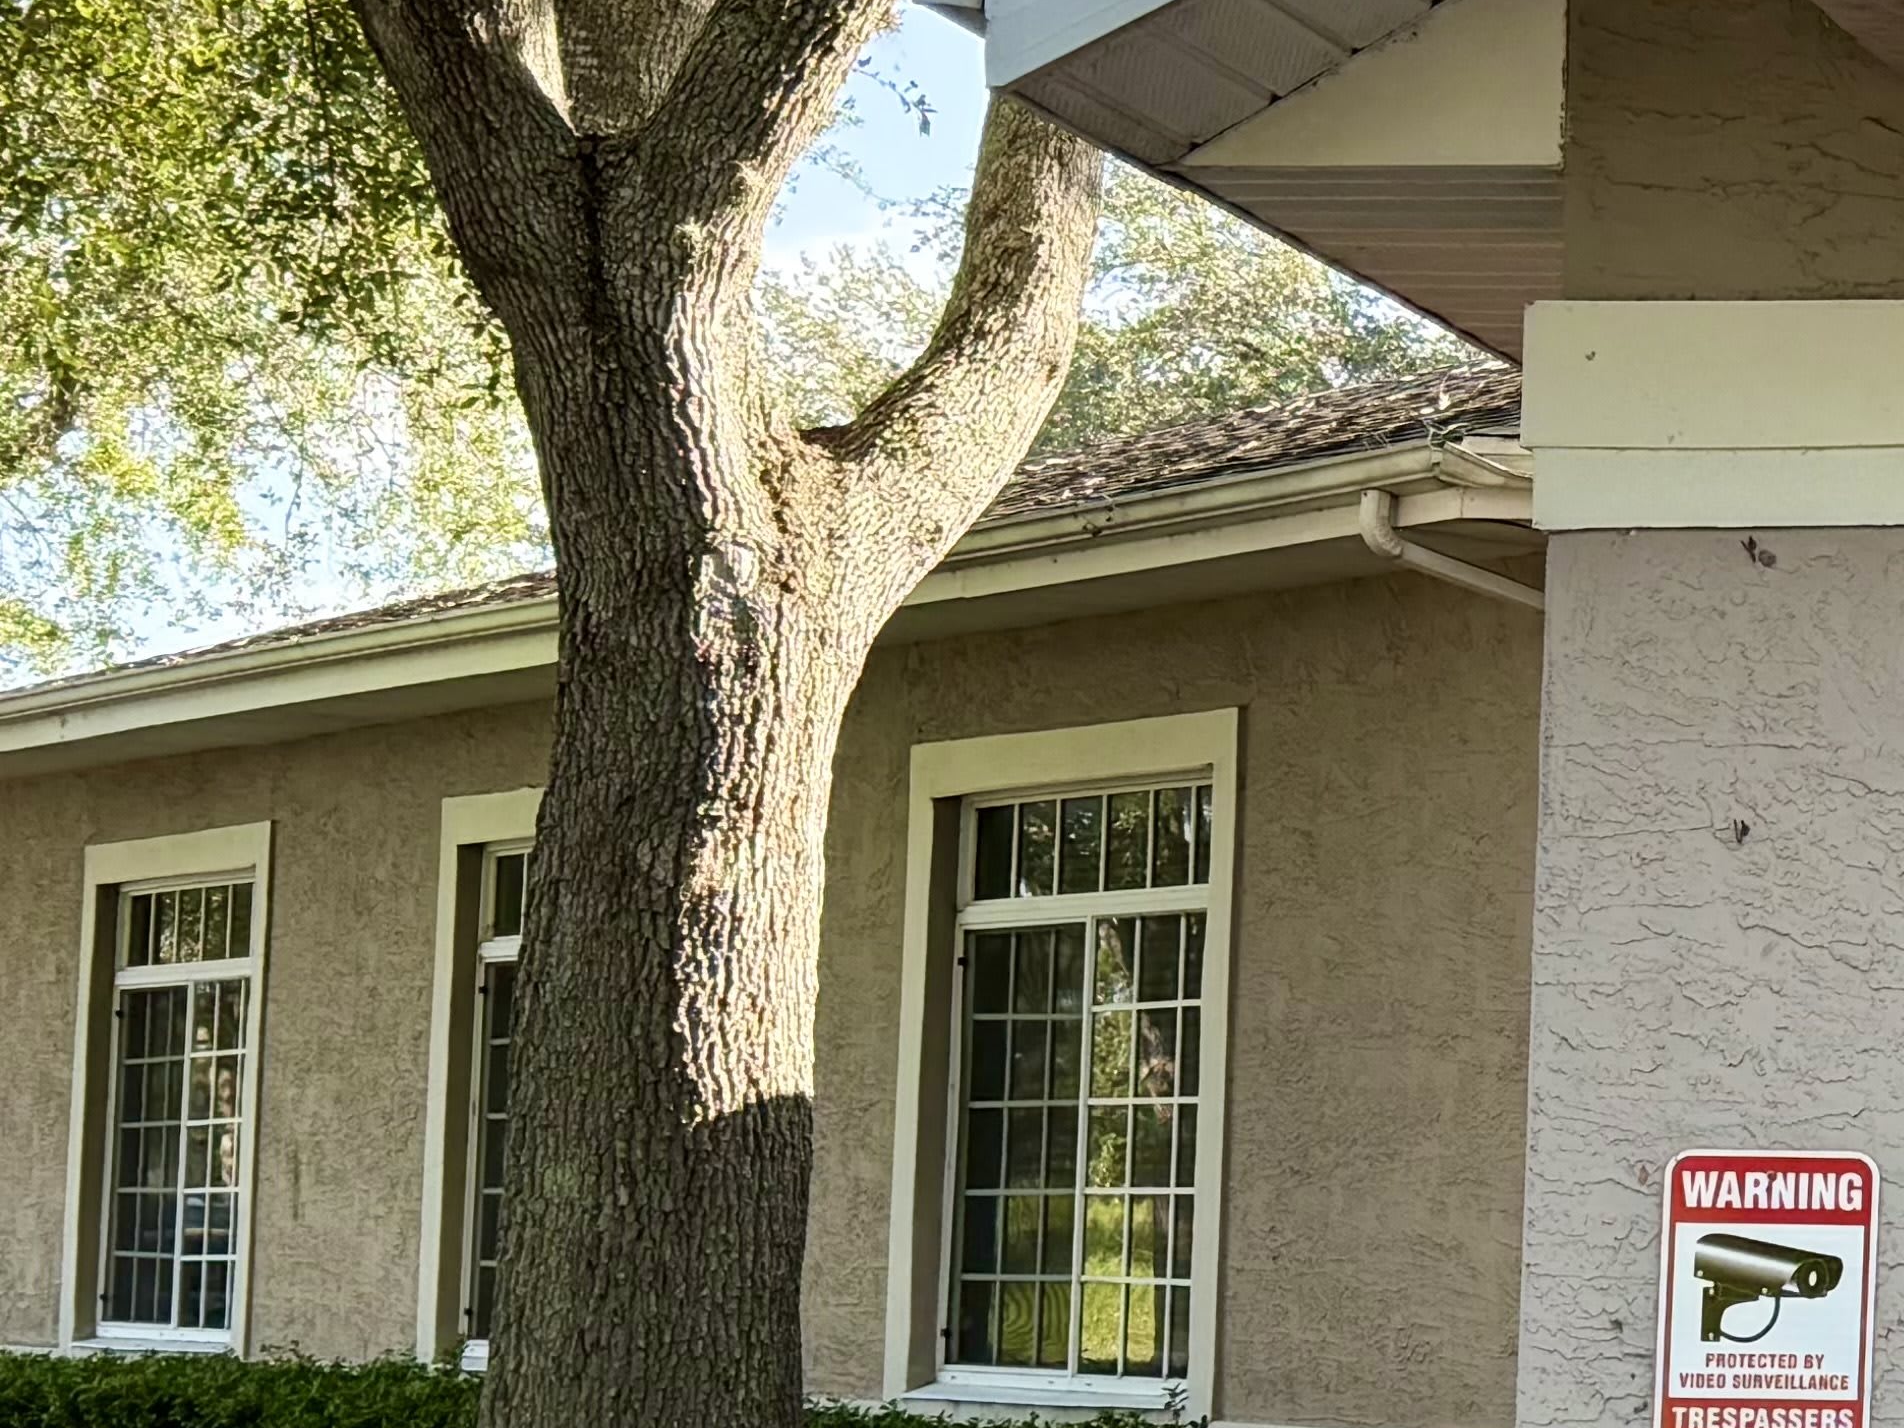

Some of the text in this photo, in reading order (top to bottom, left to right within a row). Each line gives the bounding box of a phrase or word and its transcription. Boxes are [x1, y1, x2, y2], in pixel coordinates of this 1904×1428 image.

[1682, 1170, 1863, 1211] WARNING
[1705, 1353, 1825, 1369] PROTECTED BY
[1680, 1373, 1849, 1391] VIDEO SURVEILLANCE
